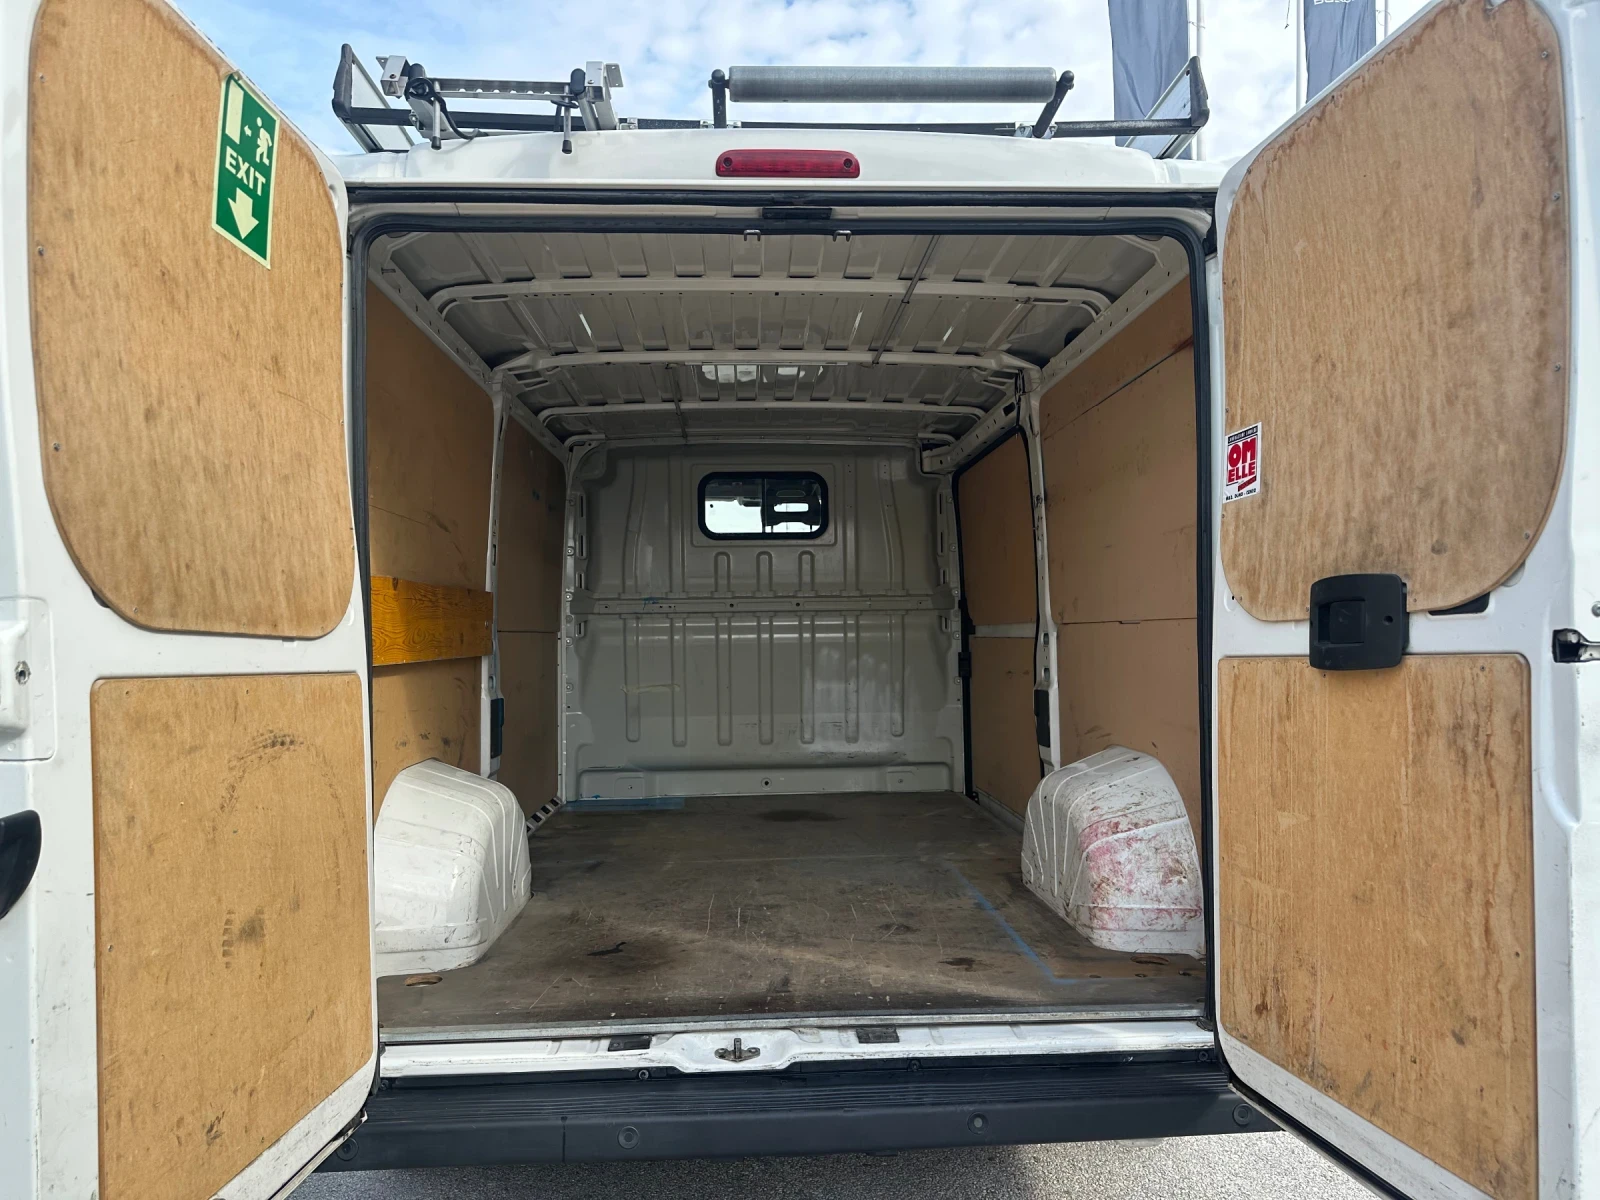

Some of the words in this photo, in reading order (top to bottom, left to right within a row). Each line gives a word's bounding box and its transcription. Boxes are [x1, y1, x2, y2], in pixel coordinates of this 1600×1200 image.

[225, 145, 266, 196] EXIT
[1228, 437, 1257, 468] OM
[1227, 461, 1256, 483] ELLE
